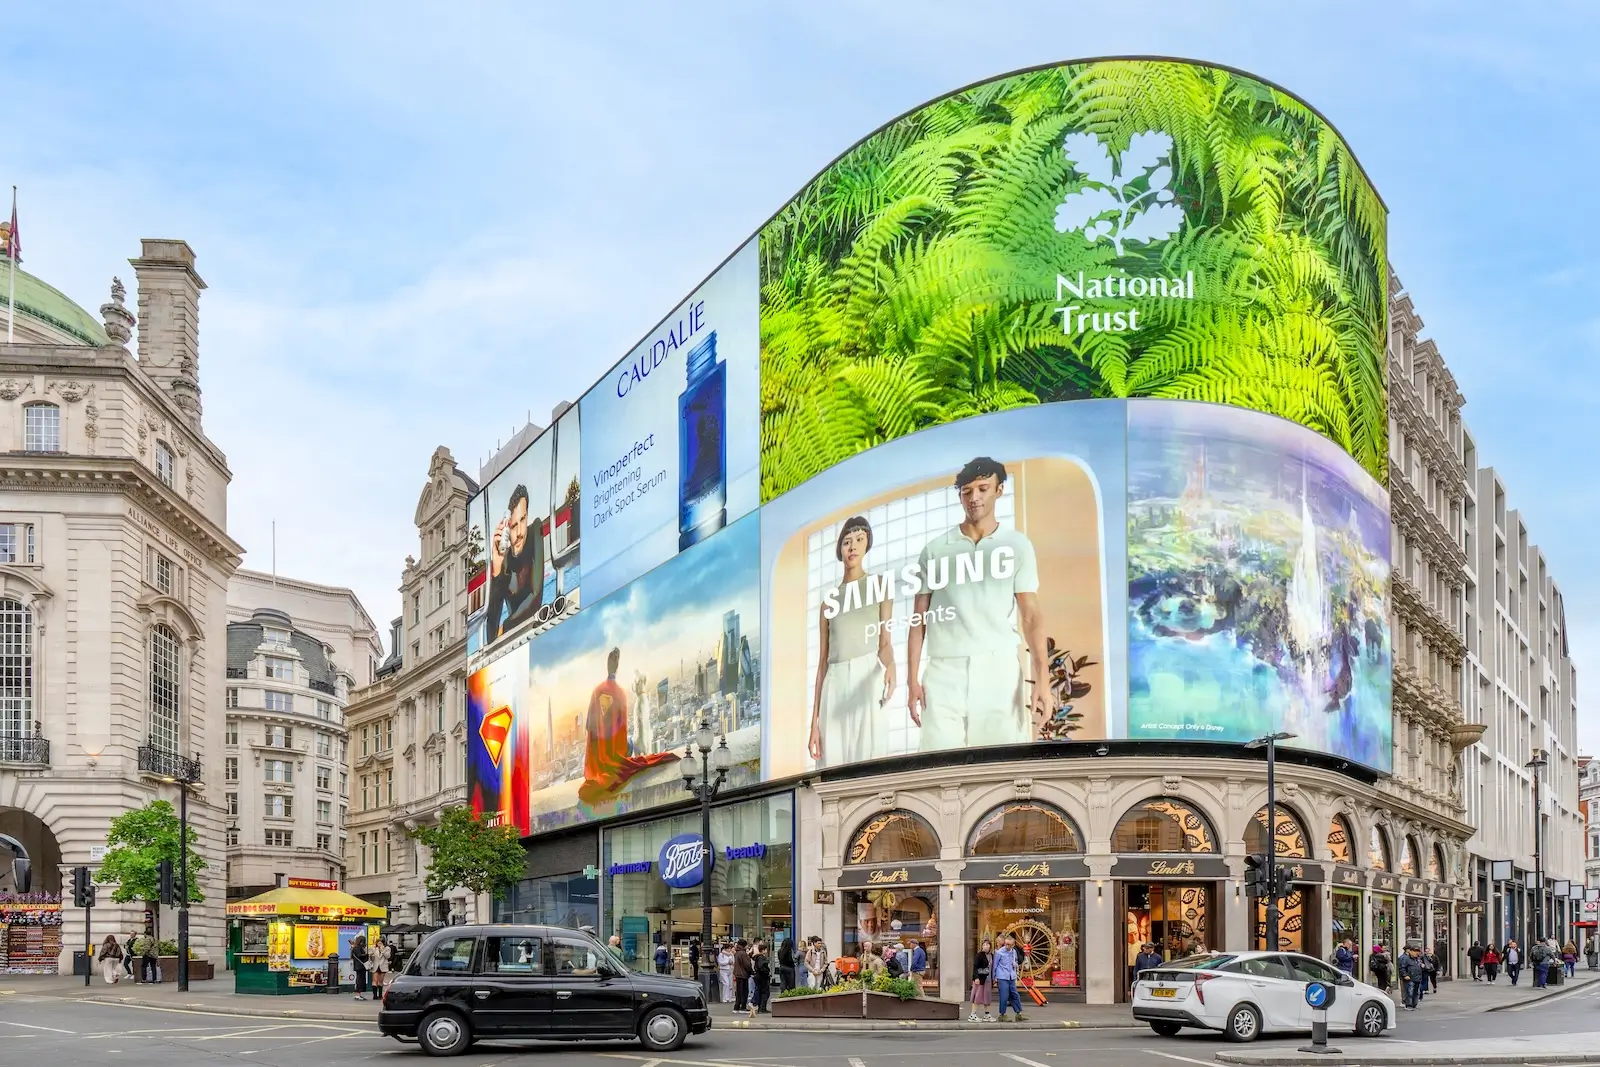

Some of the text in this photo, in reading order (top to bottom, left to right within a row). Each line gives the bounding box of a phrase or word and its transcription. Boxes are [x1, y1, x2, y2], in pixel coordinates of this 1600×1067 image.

[1056, 268, 1194, 302] National
[1054, 306, 1141, 335] Trust
[593, 433, 655, 488] Vinoperfect
[593, 466, 641, 509] Brightening
[593, 469, 667, 528] Dark Spot Serum
[128, 507, 203, 568] ALLIANCE LIFE OFFICE
[823, 545, 1015, 620] SAMSUNG
[864, 604, 957, 644] presents
[1185, 723, 1200, 731] Only
[1206, 724, 1225, 732] Disney
[662, 841, 704, 880] Boots
[725, 842, 767, 860] beauty
[608, 861, 652, 877] pharmacy
[867, 870, 901, 884] Lindt
[999, 864, 1040, 877] Lindt
[1147, 860, 1186, 875] Lindt
[228, 905, 242, 913] HOT
[300, 905, 320, 913] HOT
[241, 956, 255, 964] HOT
